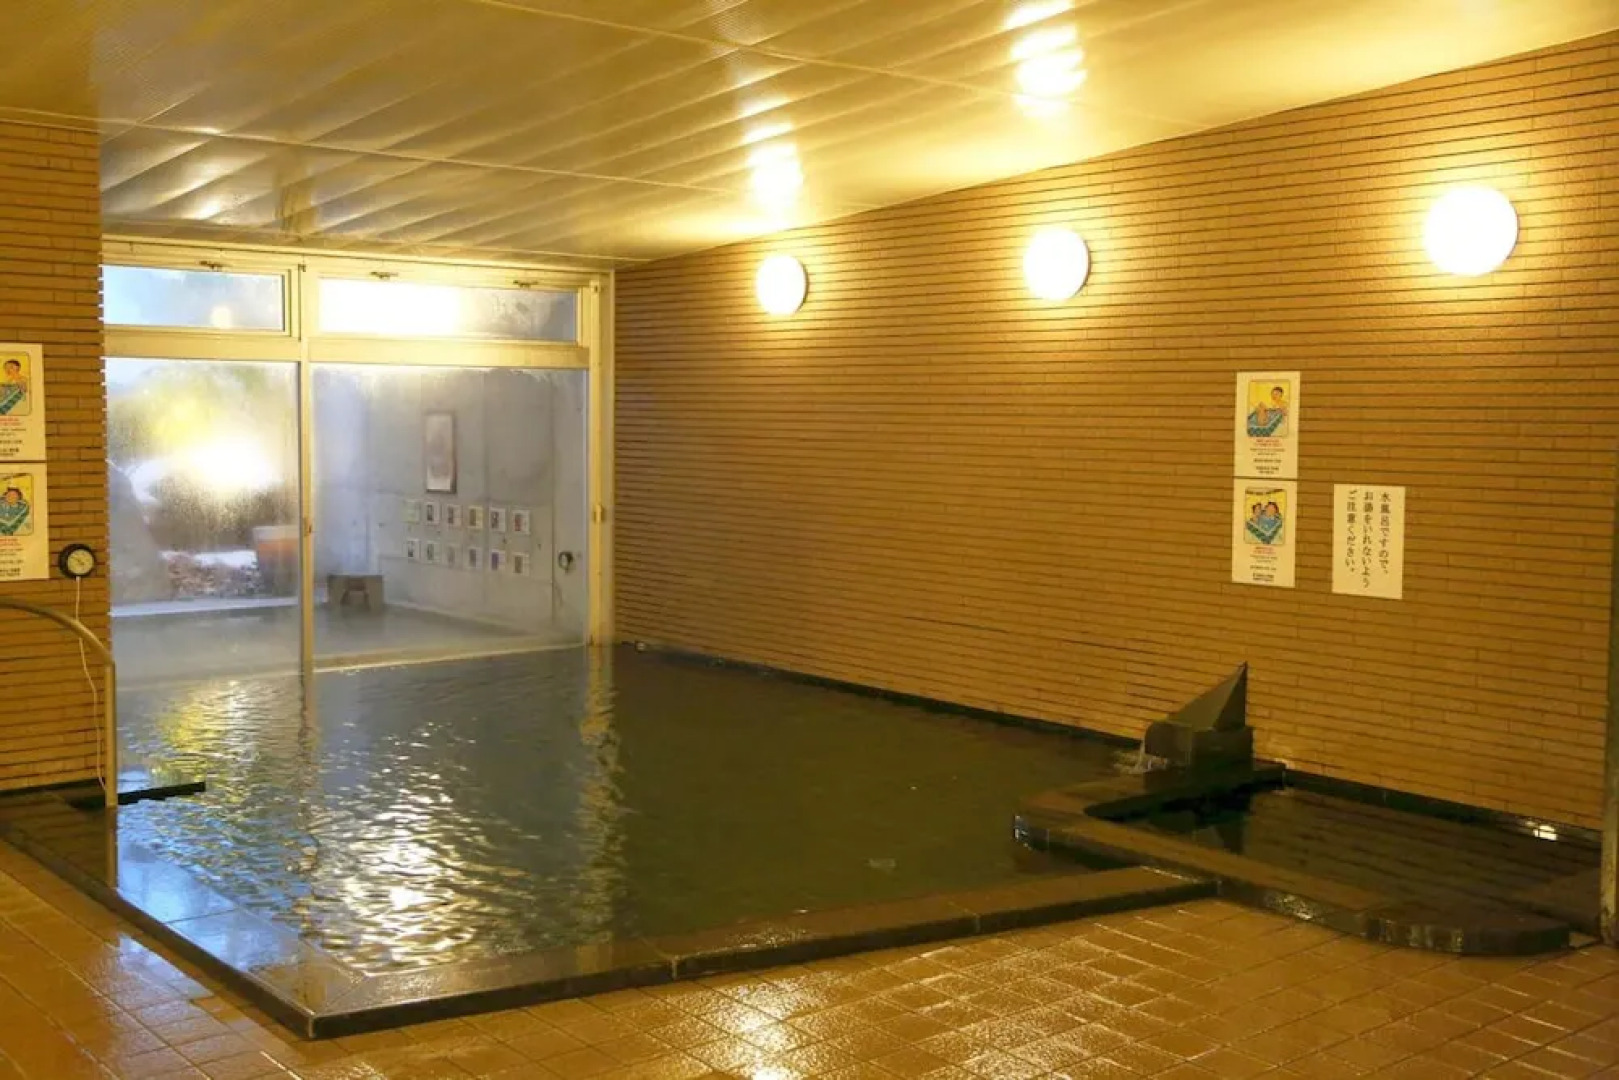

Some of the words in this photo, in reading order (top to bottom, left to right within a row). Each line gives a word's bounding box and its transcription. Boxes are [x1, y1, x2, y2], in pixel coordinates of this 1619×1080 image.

[1345, 489, 1358, 573] ご注意ください。
